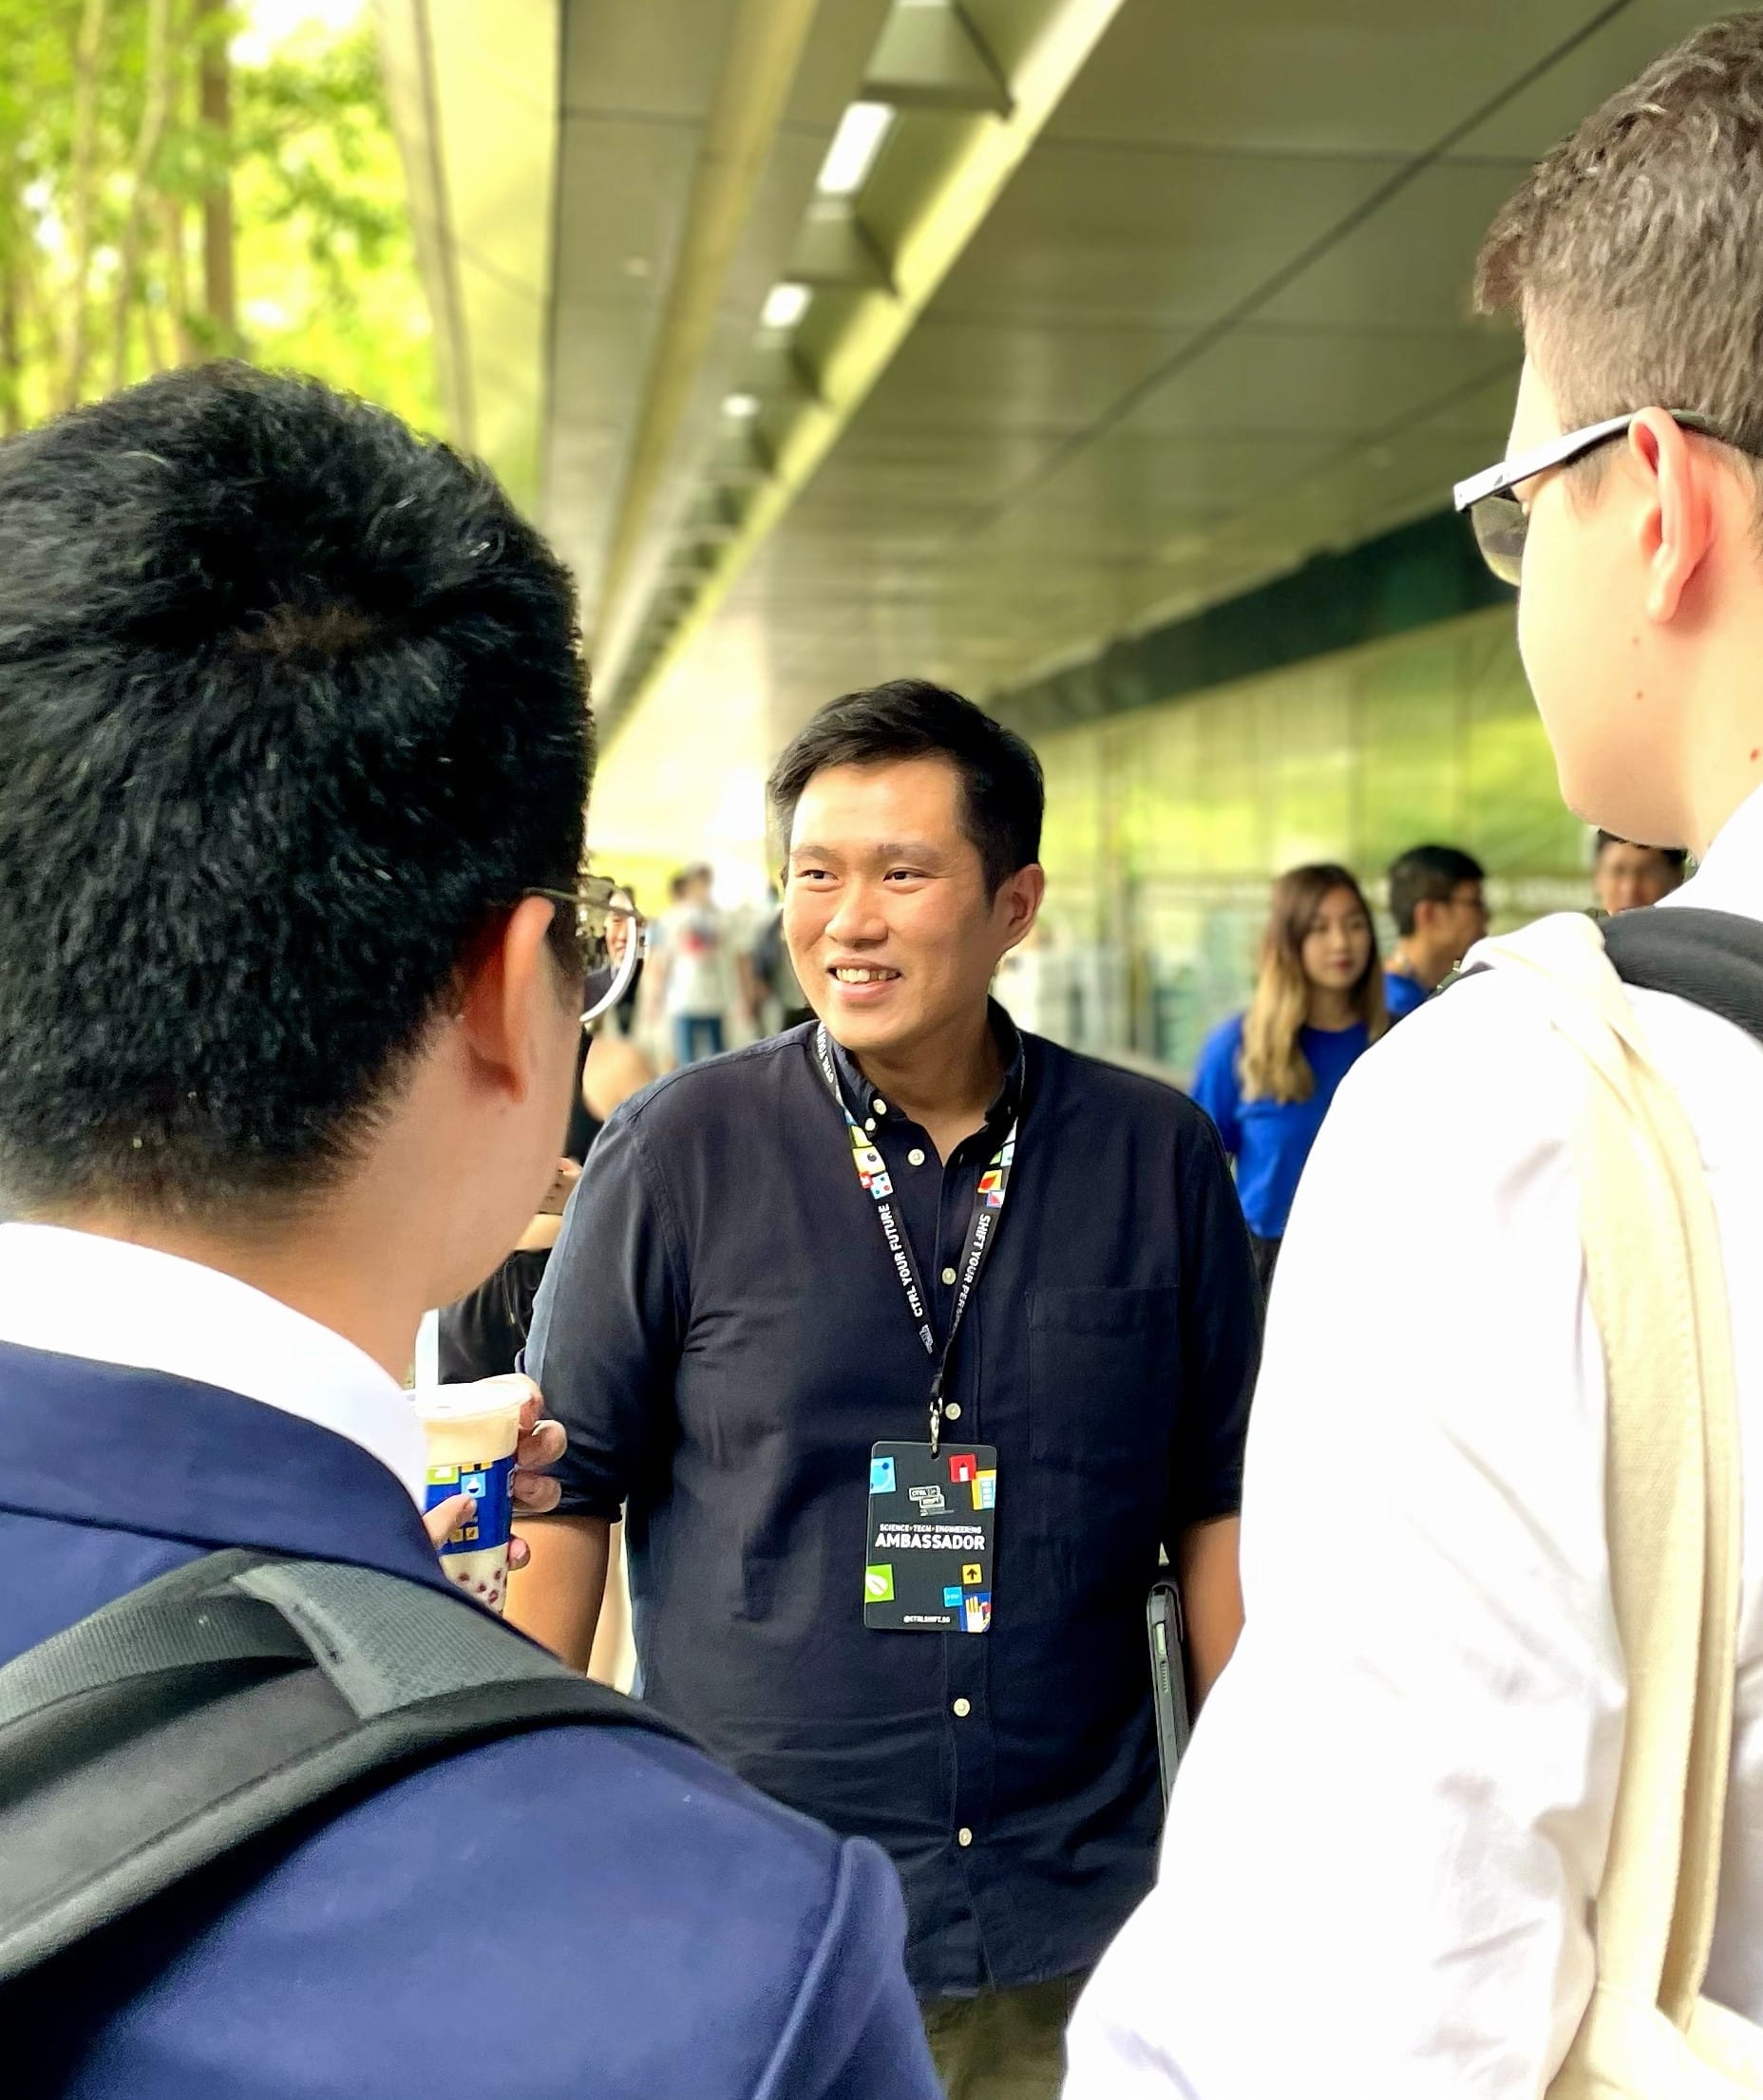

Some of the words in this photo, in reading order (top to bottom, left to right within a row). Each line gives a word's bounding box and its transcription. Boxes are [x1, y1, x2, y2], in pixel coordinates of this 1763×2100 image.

[878, 1202, 902, 1252] FUTURE
[973, 1213, 992, 1250] SHIFT
[894, 1250, 913, 1287] YOUR
[963, 1251, 982, 1283] YOUR
[906, 1285, 923, 1317] CTRL
[874, 1532, 985, 1550] AMBASSADOR
